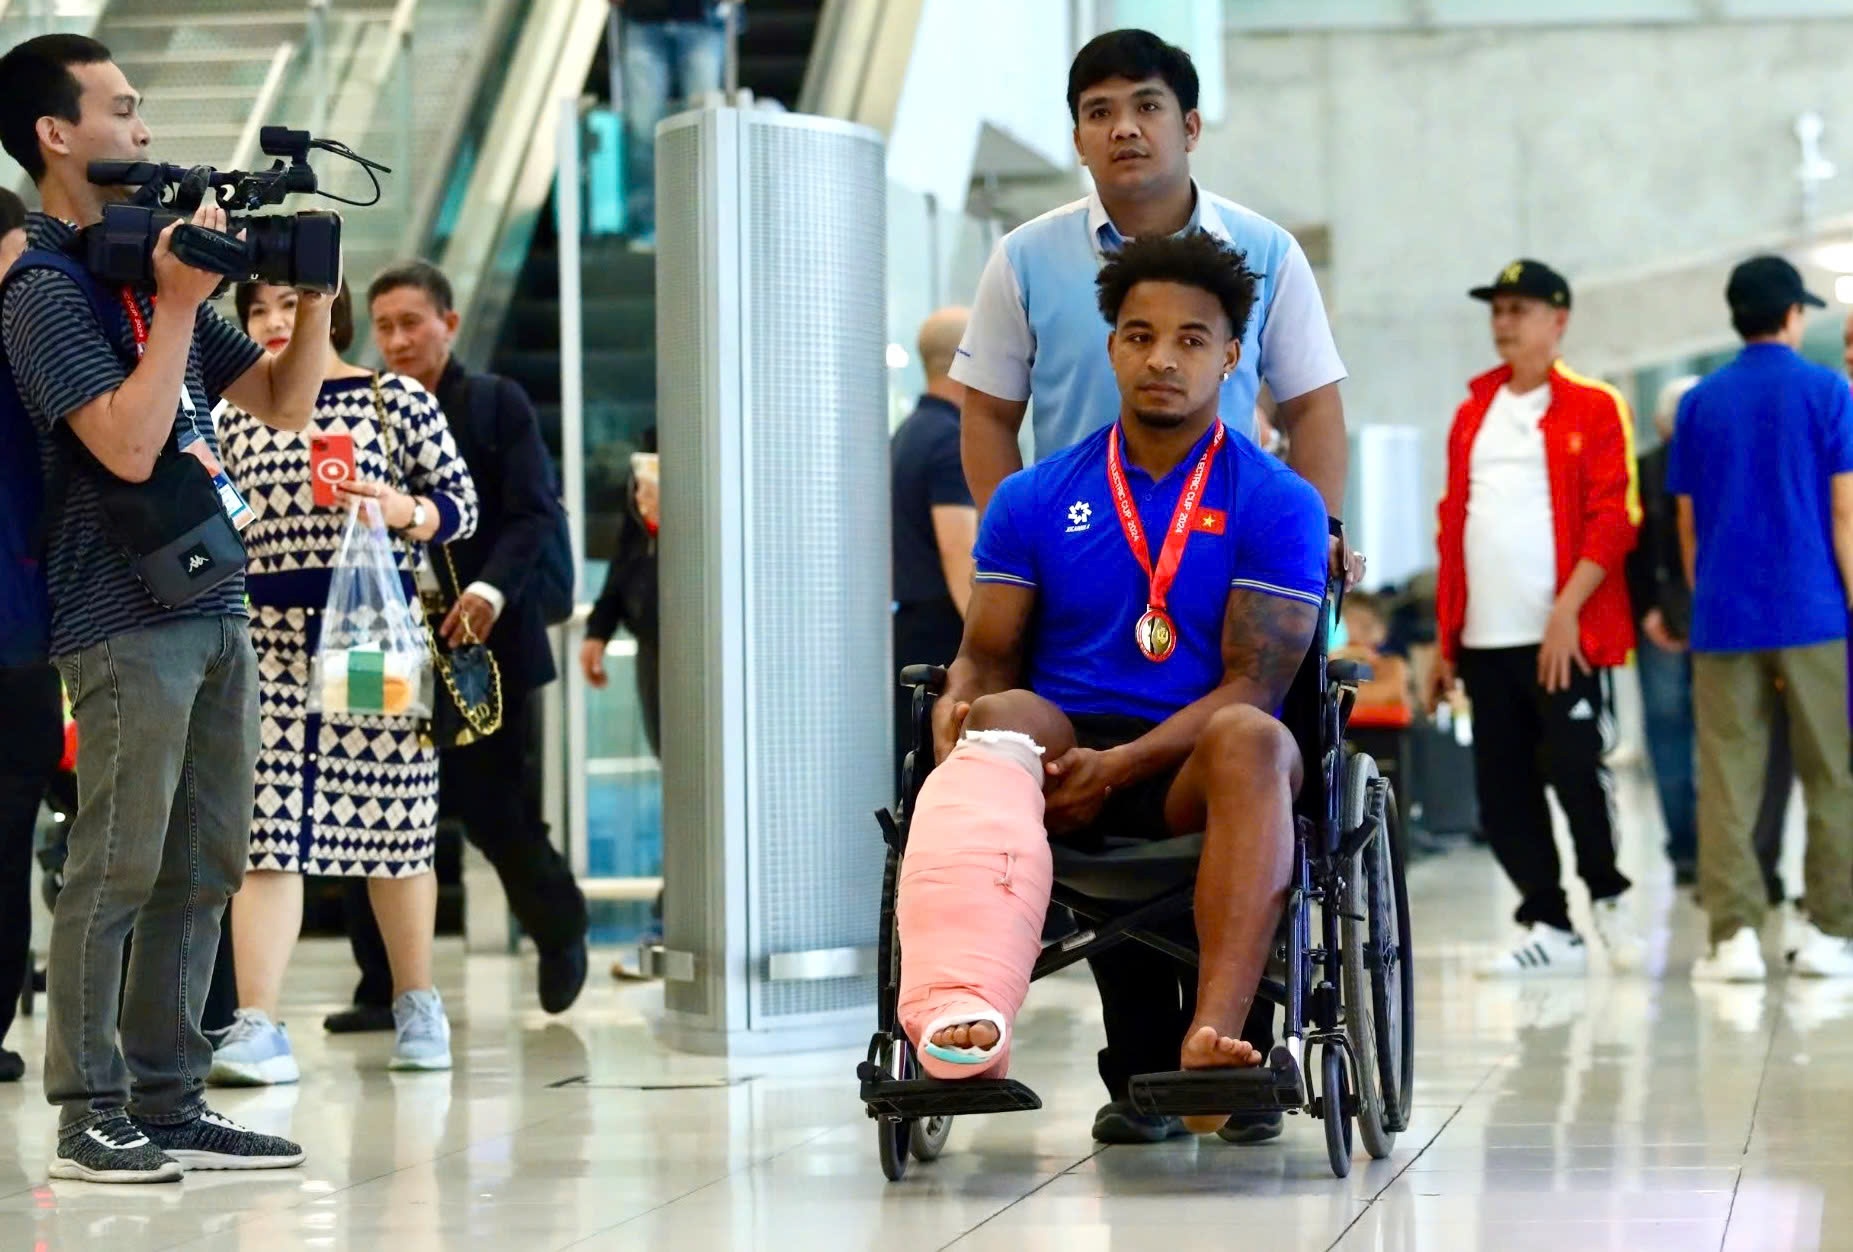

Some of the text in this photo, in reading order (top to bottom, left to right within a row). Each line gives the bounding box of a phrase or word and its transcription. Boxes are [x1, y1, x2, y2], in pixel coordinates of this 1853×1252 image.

[1110, 462, 1126, 500] ELECTRIC
[1121, 500, 1132, 518] CUP
[1127, 520, 1139, 542] 2024
[1184, 491, 1196, 511] CUP
[1175, 513, 1189, 533] 2024
